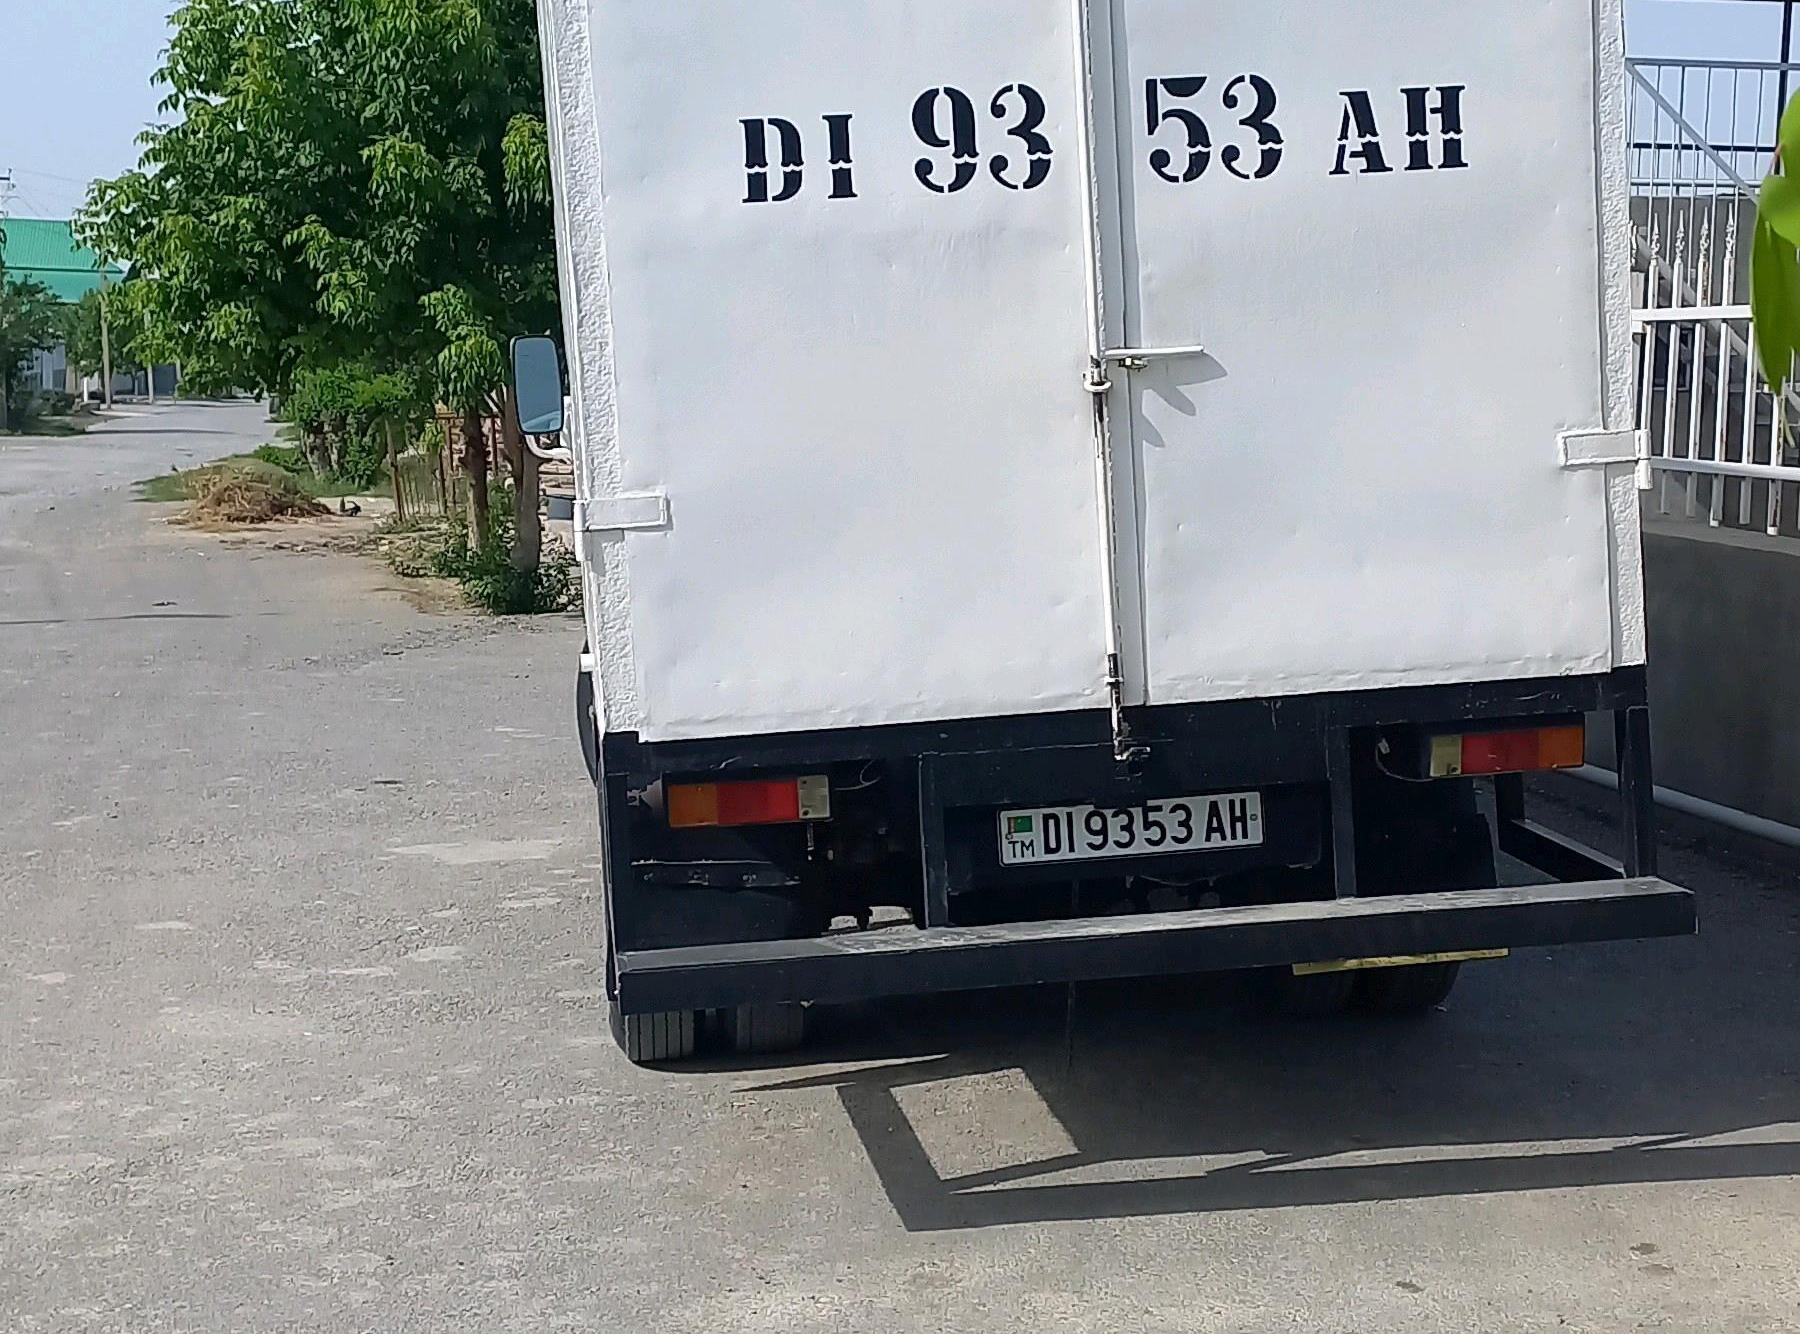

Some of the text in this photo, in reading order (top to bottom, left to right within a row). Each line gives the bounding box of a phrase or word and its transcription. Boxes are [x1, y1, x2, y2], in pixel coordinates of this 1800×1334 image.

[739, 74, 1469, 204] DI 93 53 AH
[1008, 838, 1035, 859] TM
[1041, 798, 1249, 855] DI 9353 AH
